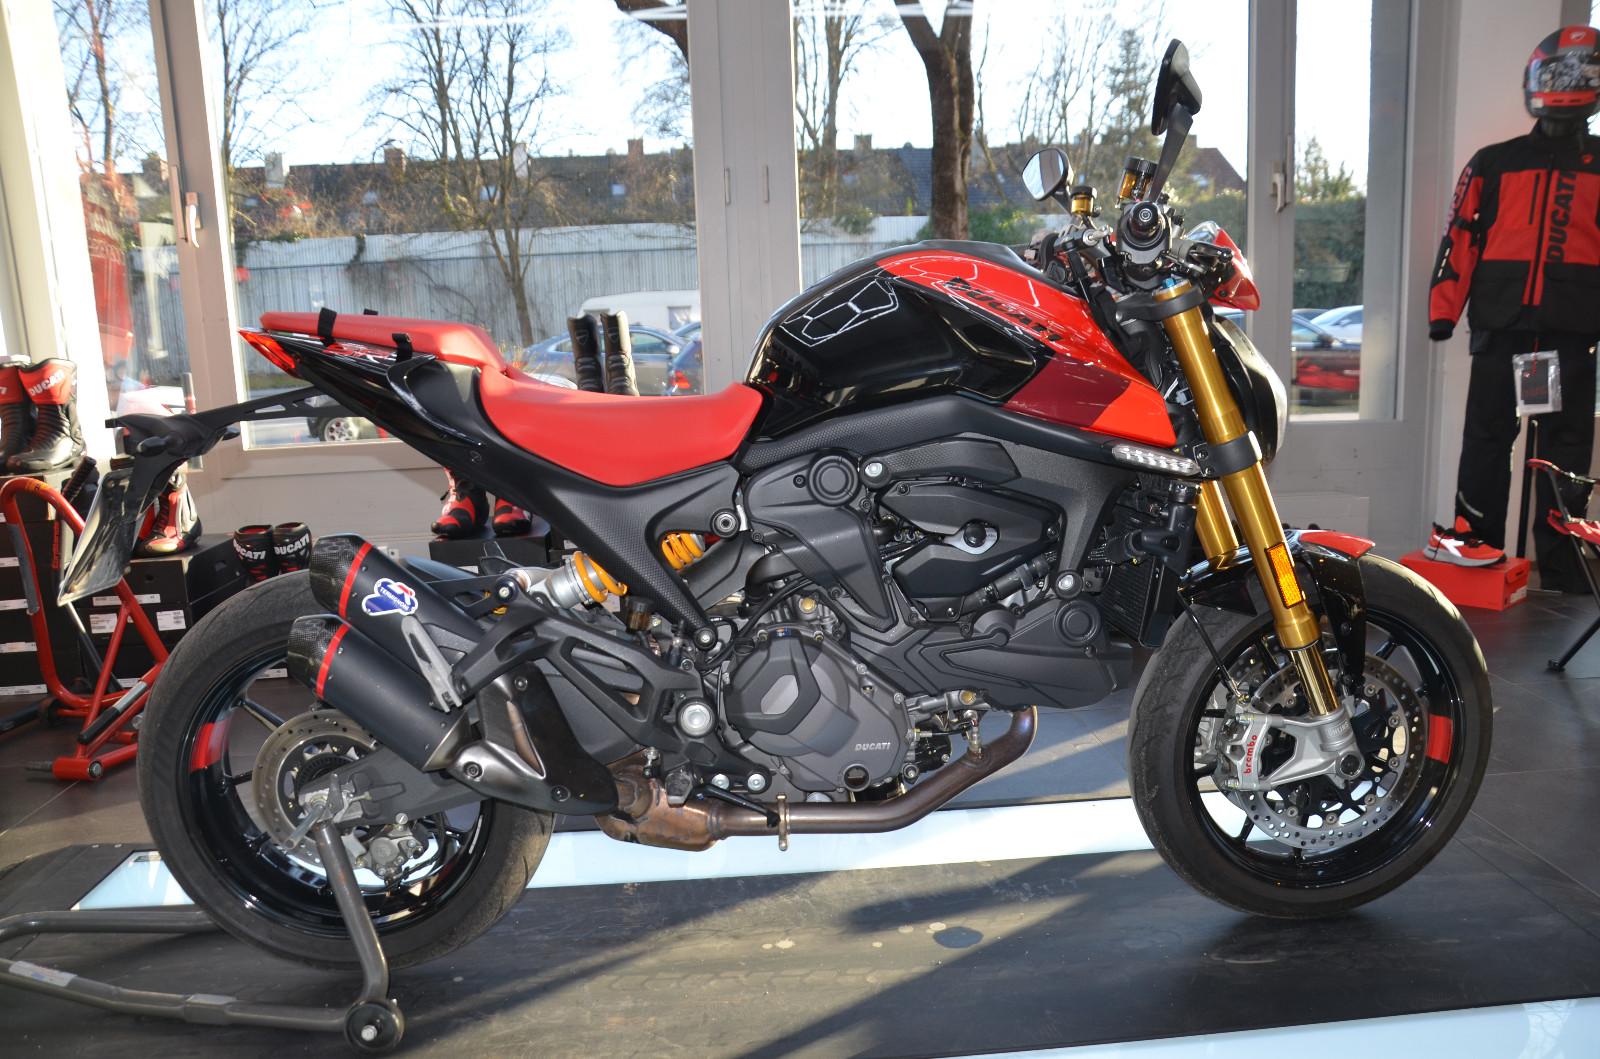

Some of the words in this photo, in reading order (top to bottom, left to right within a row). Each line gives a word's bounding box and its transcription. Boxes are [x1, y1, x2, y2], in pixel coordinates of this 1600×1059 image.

[1547, 170, 1577, 263] DUCATI
[274, 533, 310, 555] DUCATI
[854, 742, 891, 751] DUCATI
[1243, 734, 1258, 775] brembo
